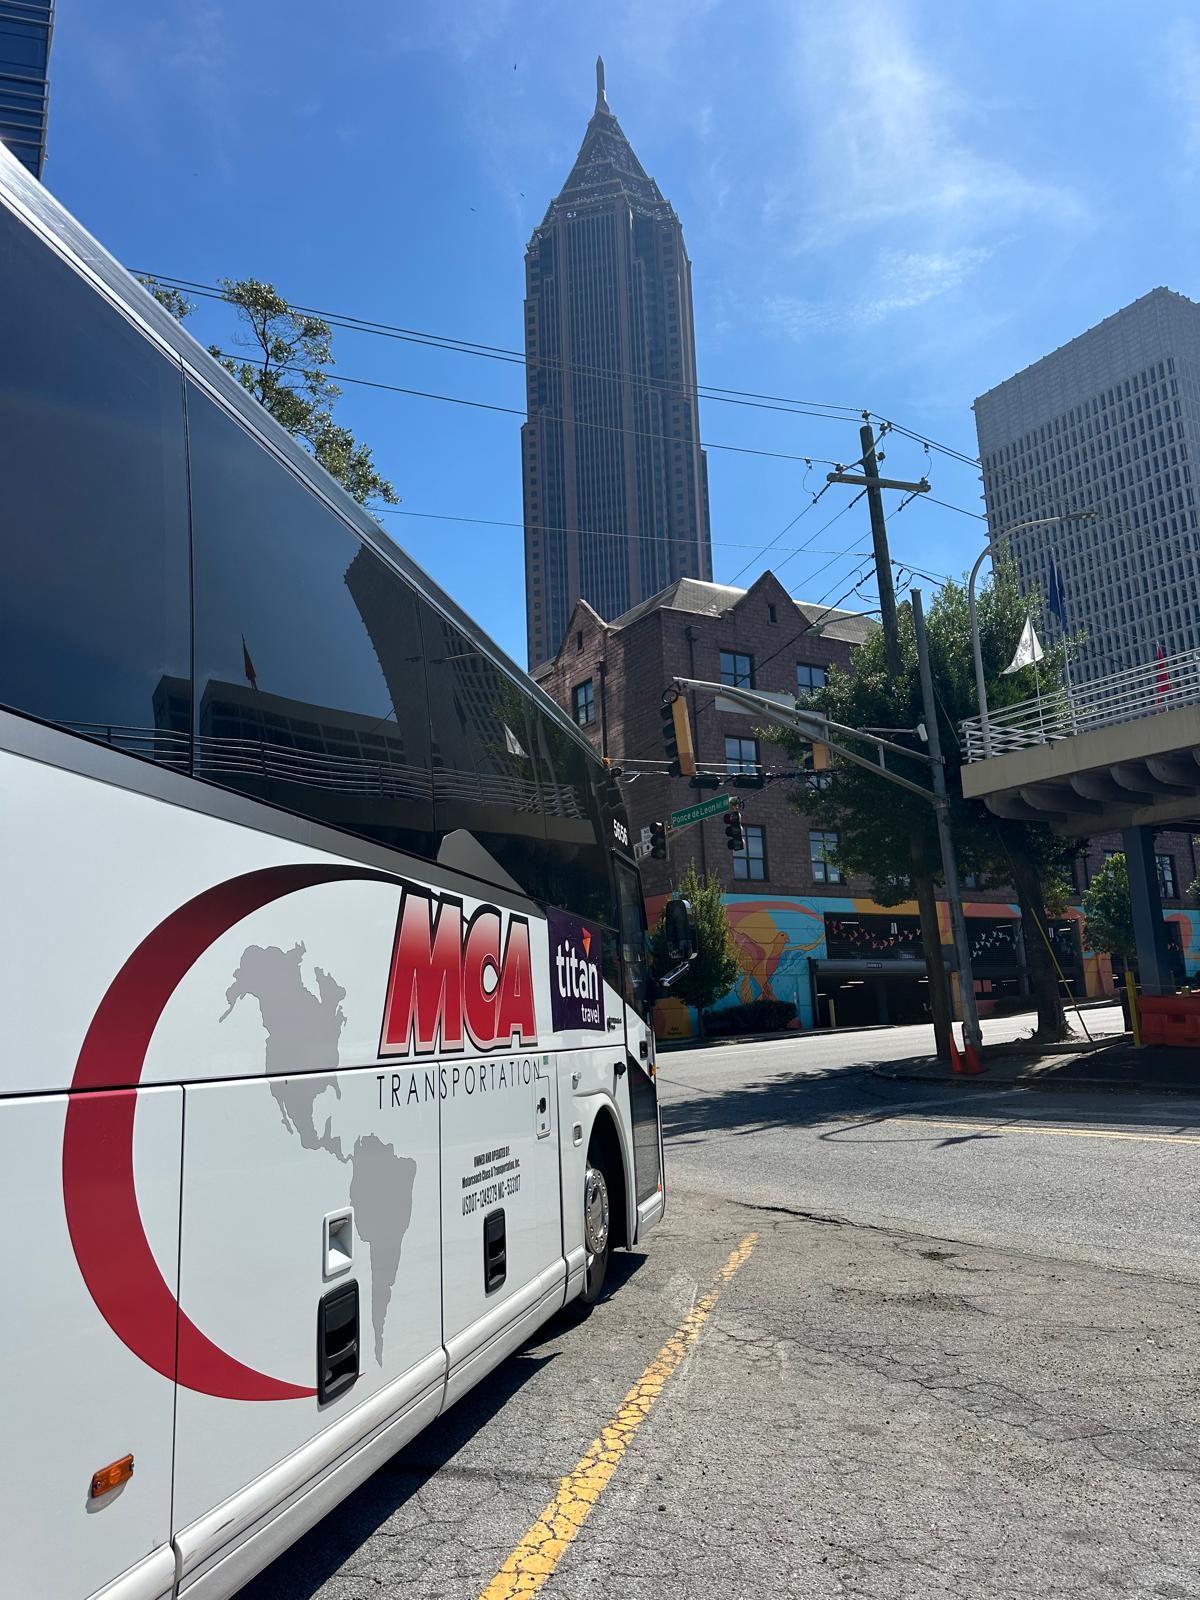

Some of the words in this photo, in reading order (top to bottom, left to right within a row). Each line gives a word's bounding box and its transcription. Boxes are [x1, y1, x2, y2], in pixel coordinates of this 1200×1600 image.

[613, 818, 628, 846] 5656
[672, 813, 691, 824] Ponce
[692, 810, 700, 818] de
[700, 804, 716, 816] Leon
[377, 886, 538, 1059] MCA
[556, 940, 599, 1000] titan
[581, 1003, 600, 1024] travel
[376, 1058, 540, 1110] TRANSPORTATION
